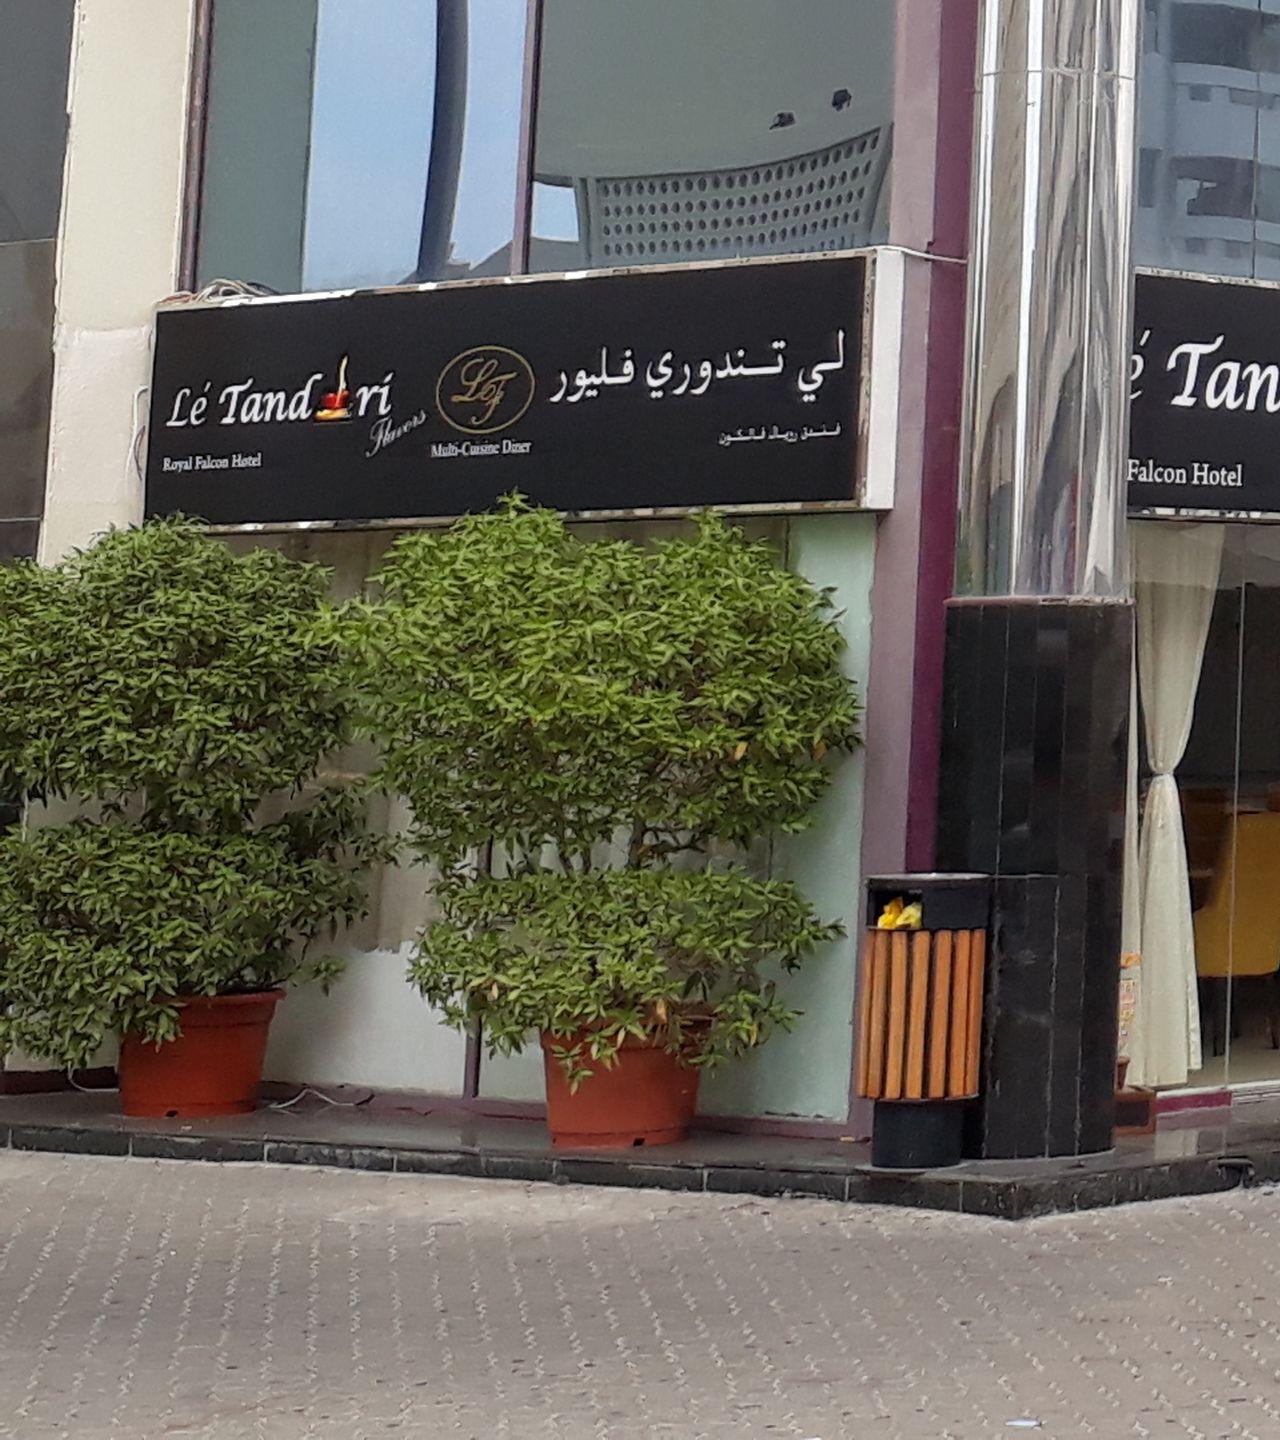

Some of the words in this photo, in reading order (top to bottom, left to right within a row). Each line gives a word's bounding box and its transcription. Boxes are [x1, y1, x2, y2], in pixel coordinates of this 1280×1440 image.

[549, 346, 635, 402] فليور
[645, 339, 787, 399] تندوري
[798, 329, 844, 402] لي
[163, 456, 193, 472] Royal
[195, 455, 229, 469] Falcon
[231, 452, 262, 468] Hotel
[1127, 459, 1187, 485] Falcon
[1191, 462, 1243, 488] Hotel
